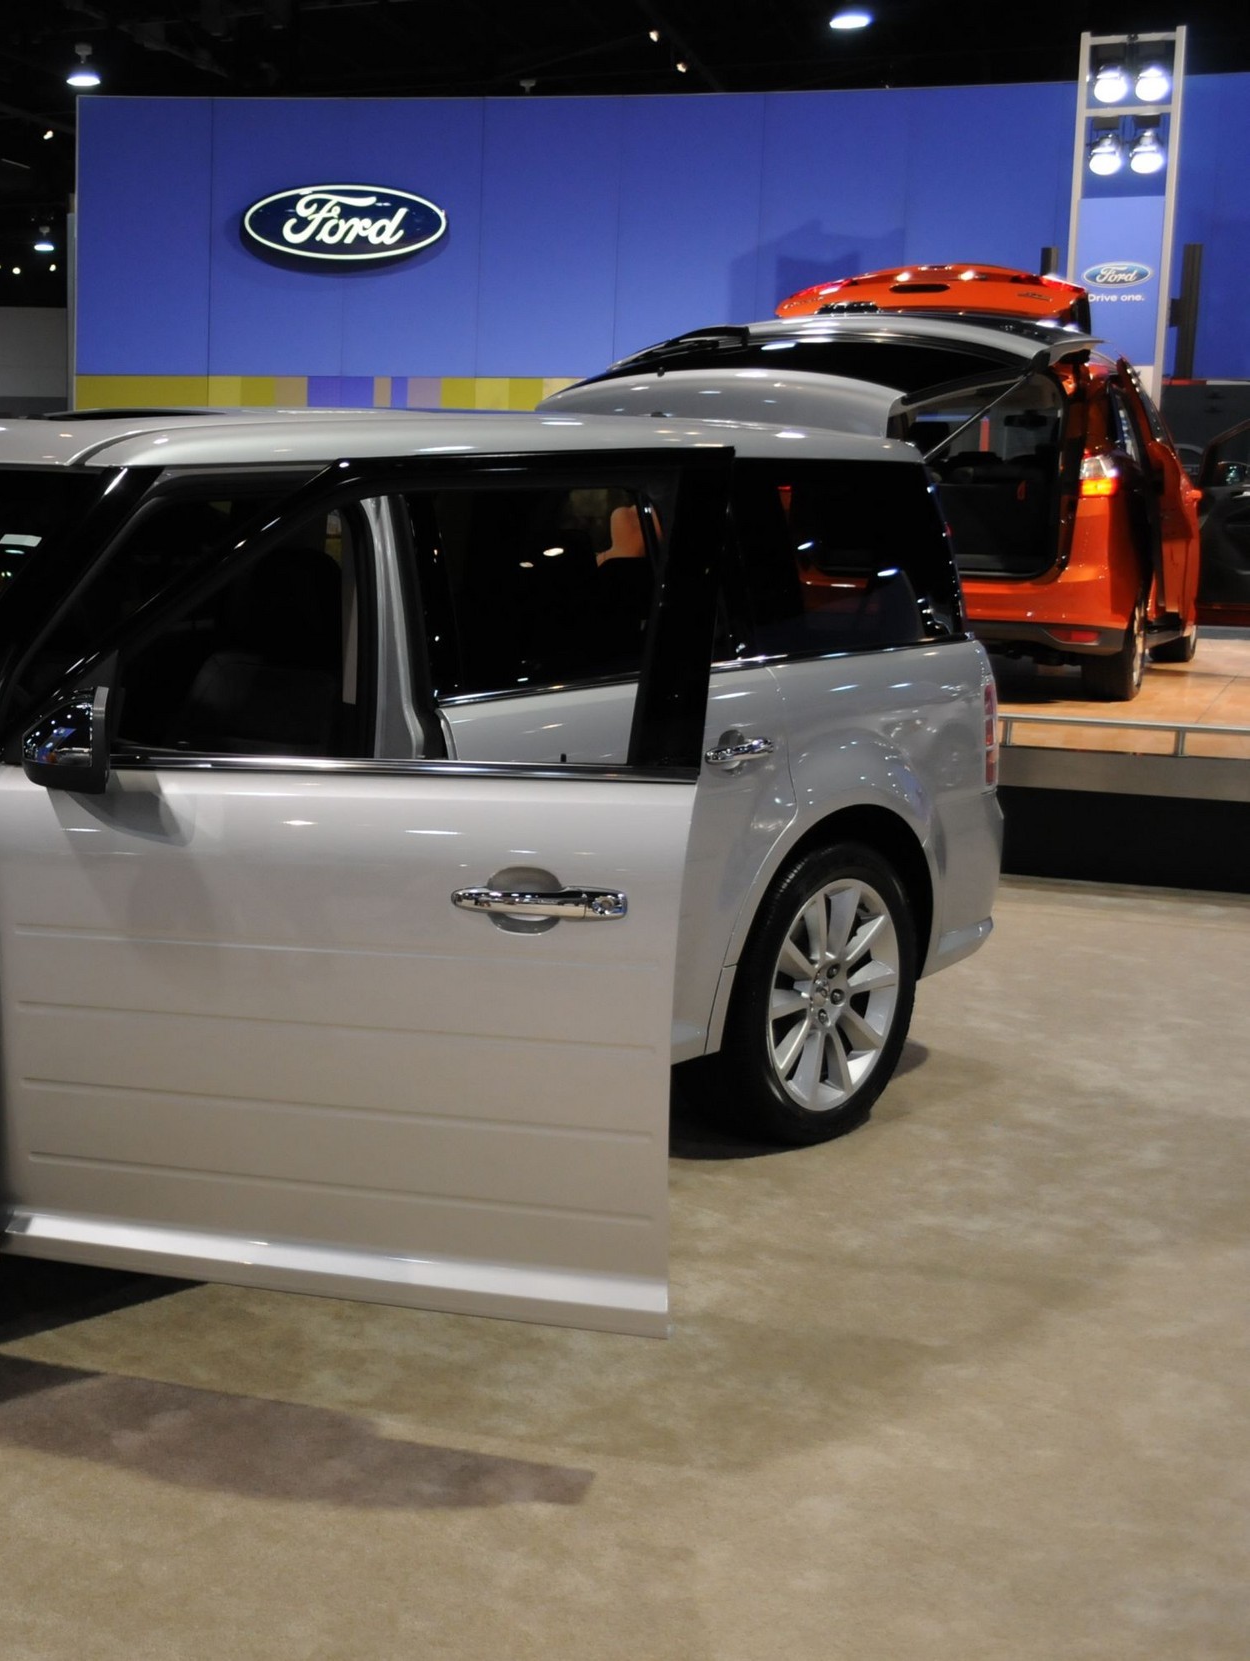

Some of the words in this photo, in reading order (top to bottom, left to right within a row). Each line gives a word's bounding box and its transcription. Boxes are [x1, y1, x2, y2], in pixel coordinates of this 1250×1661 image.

[282, 193, 408, 245] Ford
[1095, 265, 1138, 283] Ford
[1087, 293, 1118, 303] Drive
[1120, 294, 1145, 303] one.
